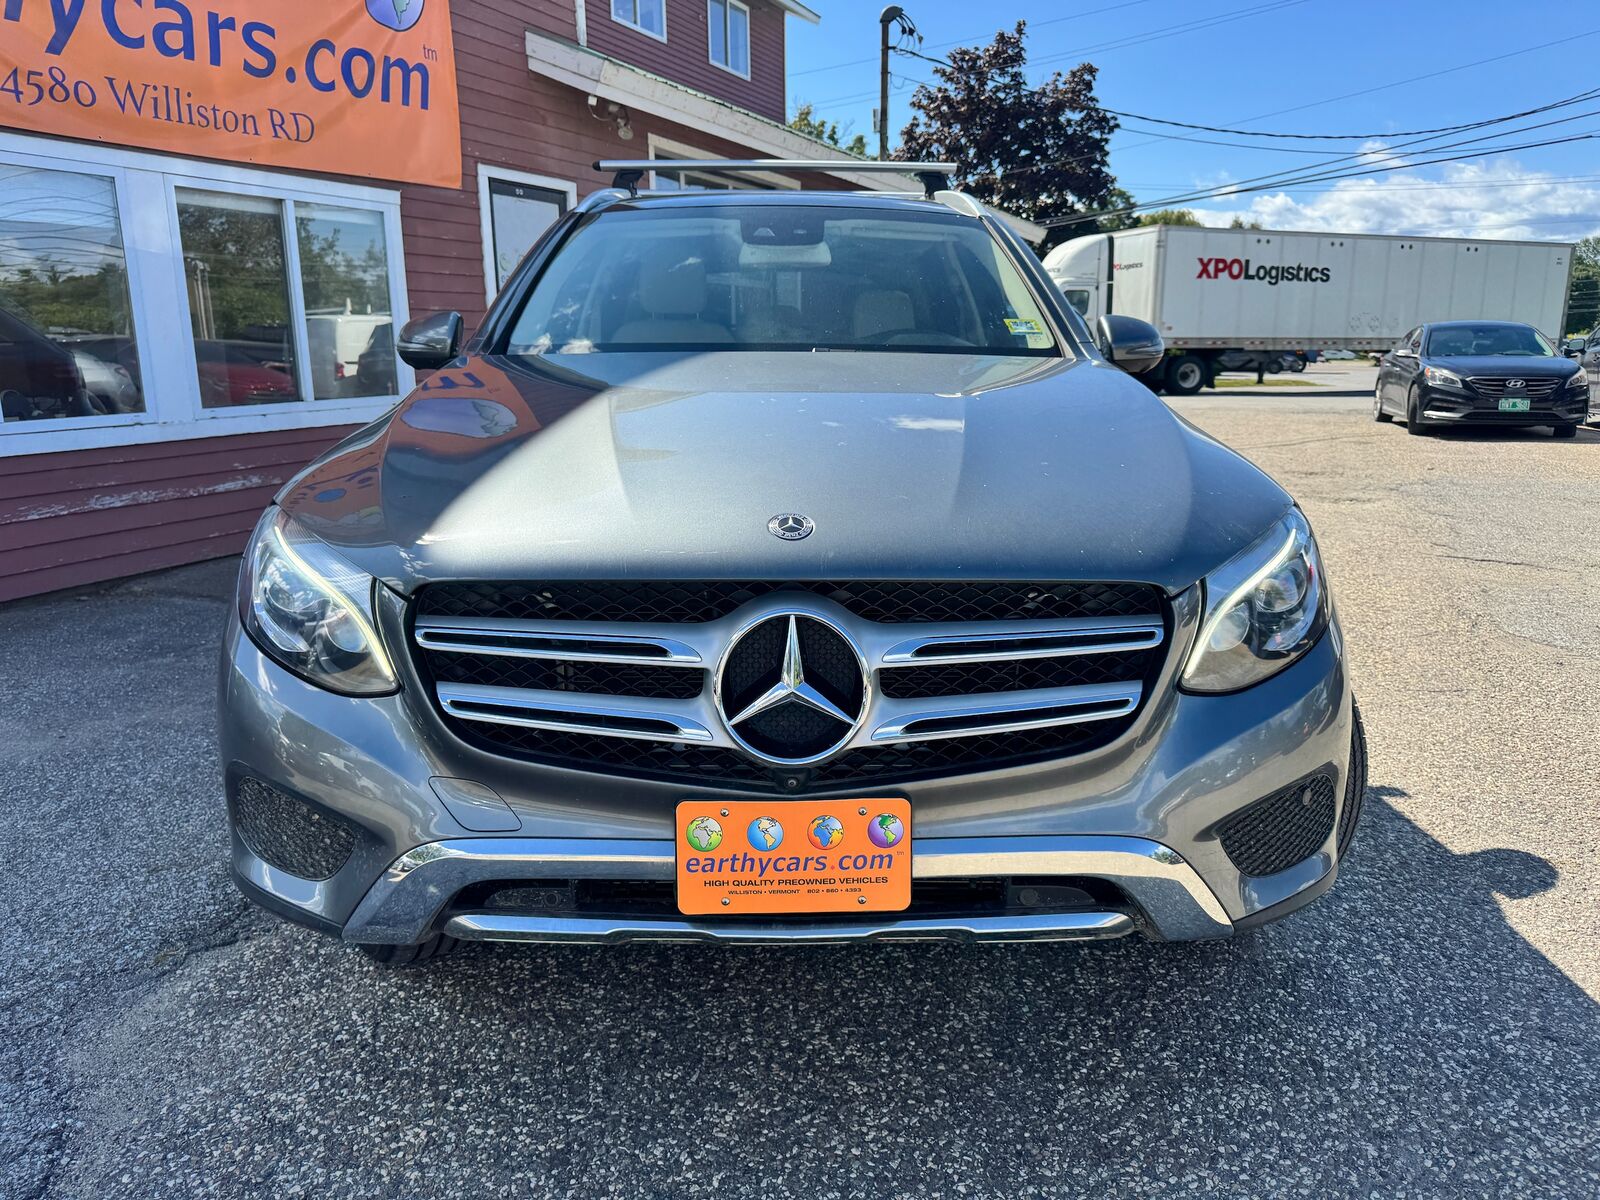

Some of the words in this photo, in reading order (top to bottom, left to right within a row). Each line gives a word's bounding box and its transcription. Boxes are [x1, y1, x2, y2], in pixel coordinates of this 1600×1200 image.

[0, 66, 97, 108] 4580
[104, 76, 260, 137] Williston
[270, 108, 315, 143] RD
[703, 879, 730, 887] HIGH
[732, 879, 775, 887] QUALITY
[777, 877, 836, 886] PREOWNED
[839, 876, 889, 885] VEHICLES
